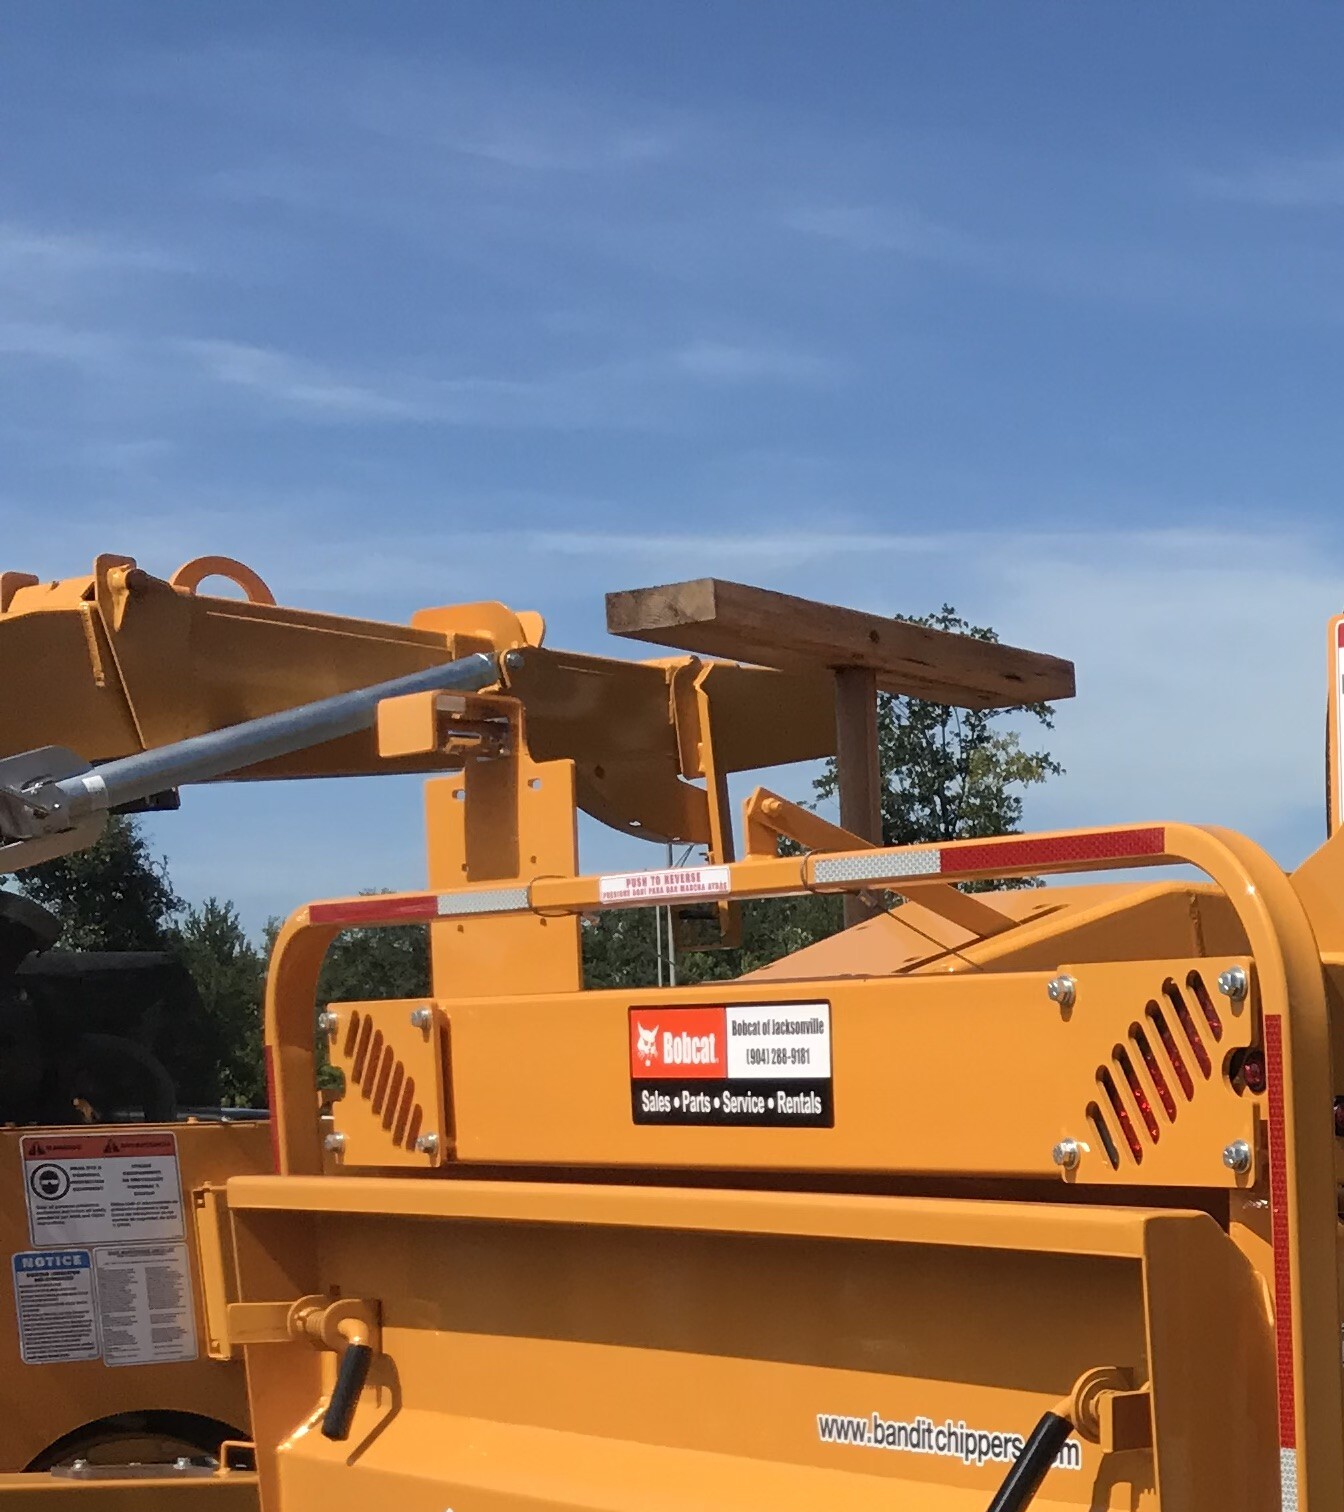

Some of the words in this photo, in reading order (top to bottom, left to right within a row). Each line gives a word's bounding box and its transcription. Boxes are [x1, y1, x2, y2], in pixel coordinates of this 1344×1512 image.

[626, 876, 648, 888] PUSH
[650, 875, 661, 886] TO
[664, 872, 701, 885] REVERSE
[732, 1019, 760, 1036] Bobcat
[762, 1020, 771, 1035] of
[772, 1017, 825, 1035] Jacksonville
[663, 1032, 716, 1064] Bobcat
[746, 1048, 770, 1066] (904)
[772, 1047, 811, 1065] 288-9181
[642, 1089, 671, 1113] Sales
[682, 1090, 711, 1114] Parts
[722, 1089, 765, 1114] Service
[777, 1090, 822, 1115] Rentals
[22, 1255, 82, 1269] NOTICE
[818, 1414, 1081, 1467] www.banditchippersm
